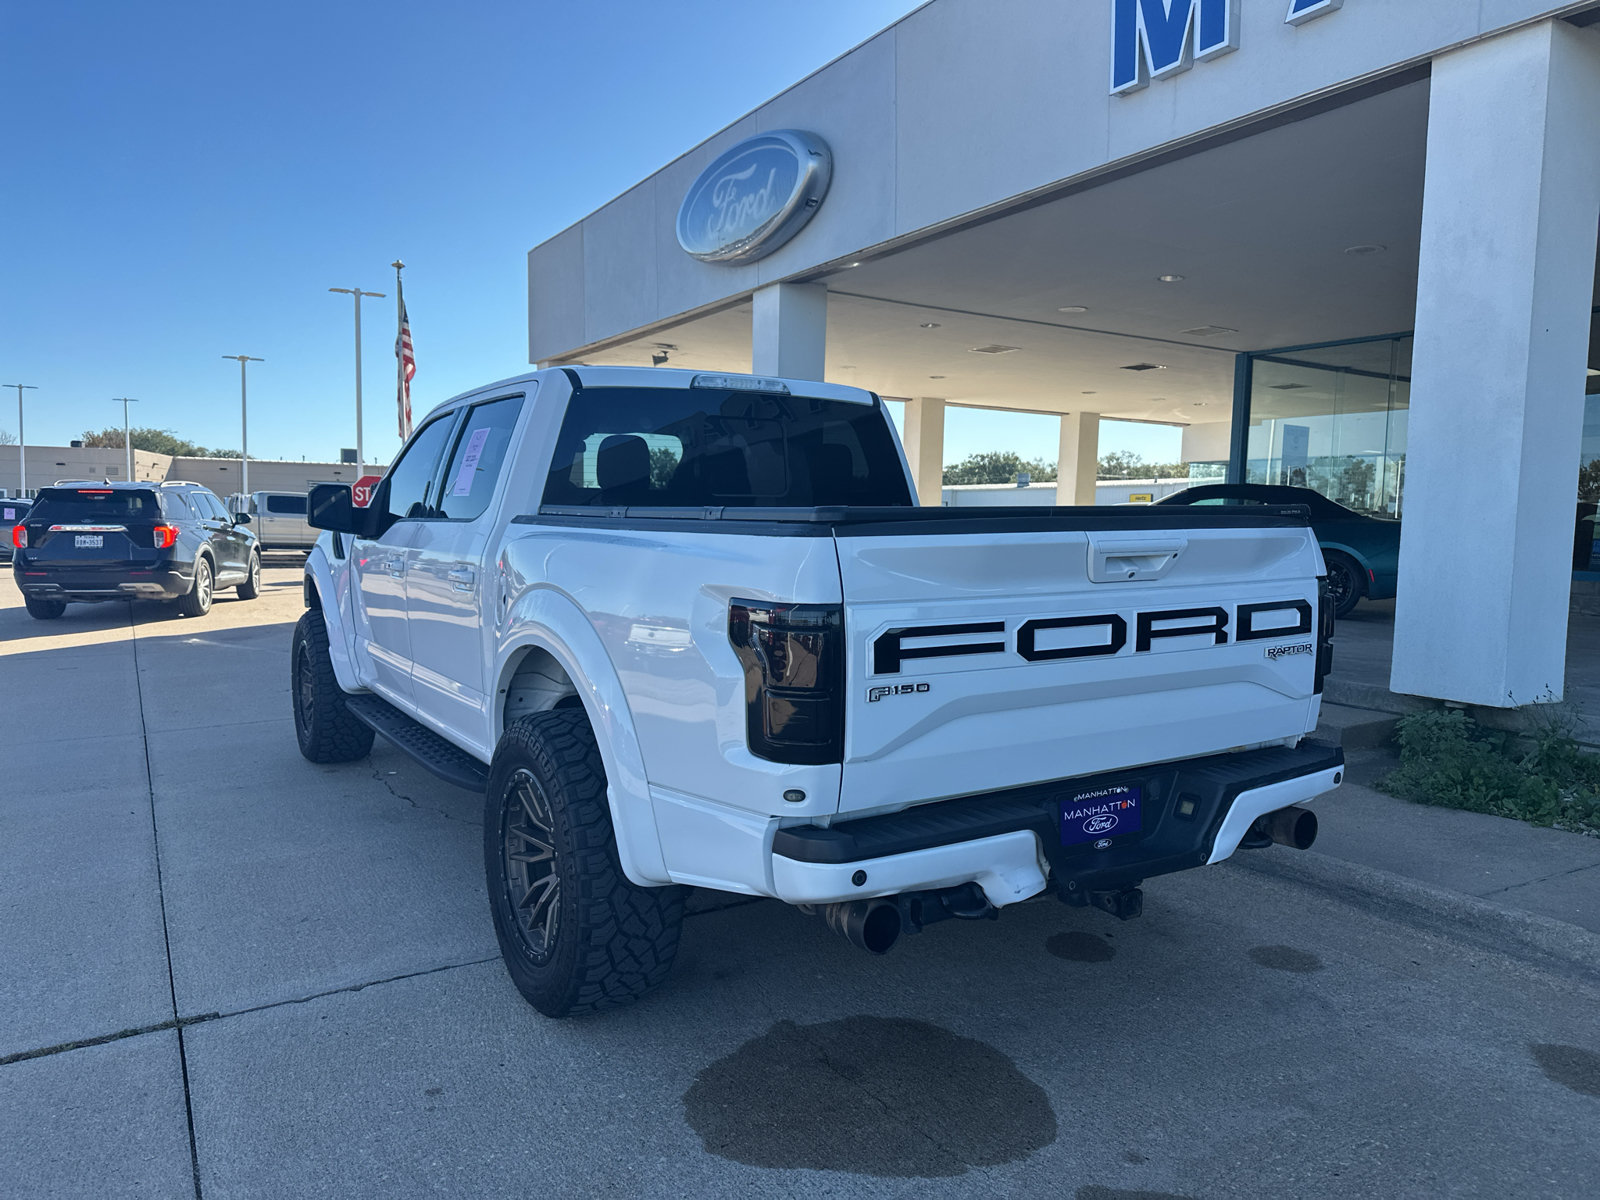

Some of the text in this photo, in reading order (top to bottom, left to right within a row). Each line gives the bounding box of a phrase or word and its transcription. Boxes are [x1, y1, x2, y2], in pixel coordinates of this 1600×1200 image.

[707, 163, 777, 239] Ford
[354, 486, 371, 502] ST
[873, 598, 1312, 675] FORD
[1265, 643, 1313, 660] RAPTOR
[1089, 817, 1113, 831] Ford
